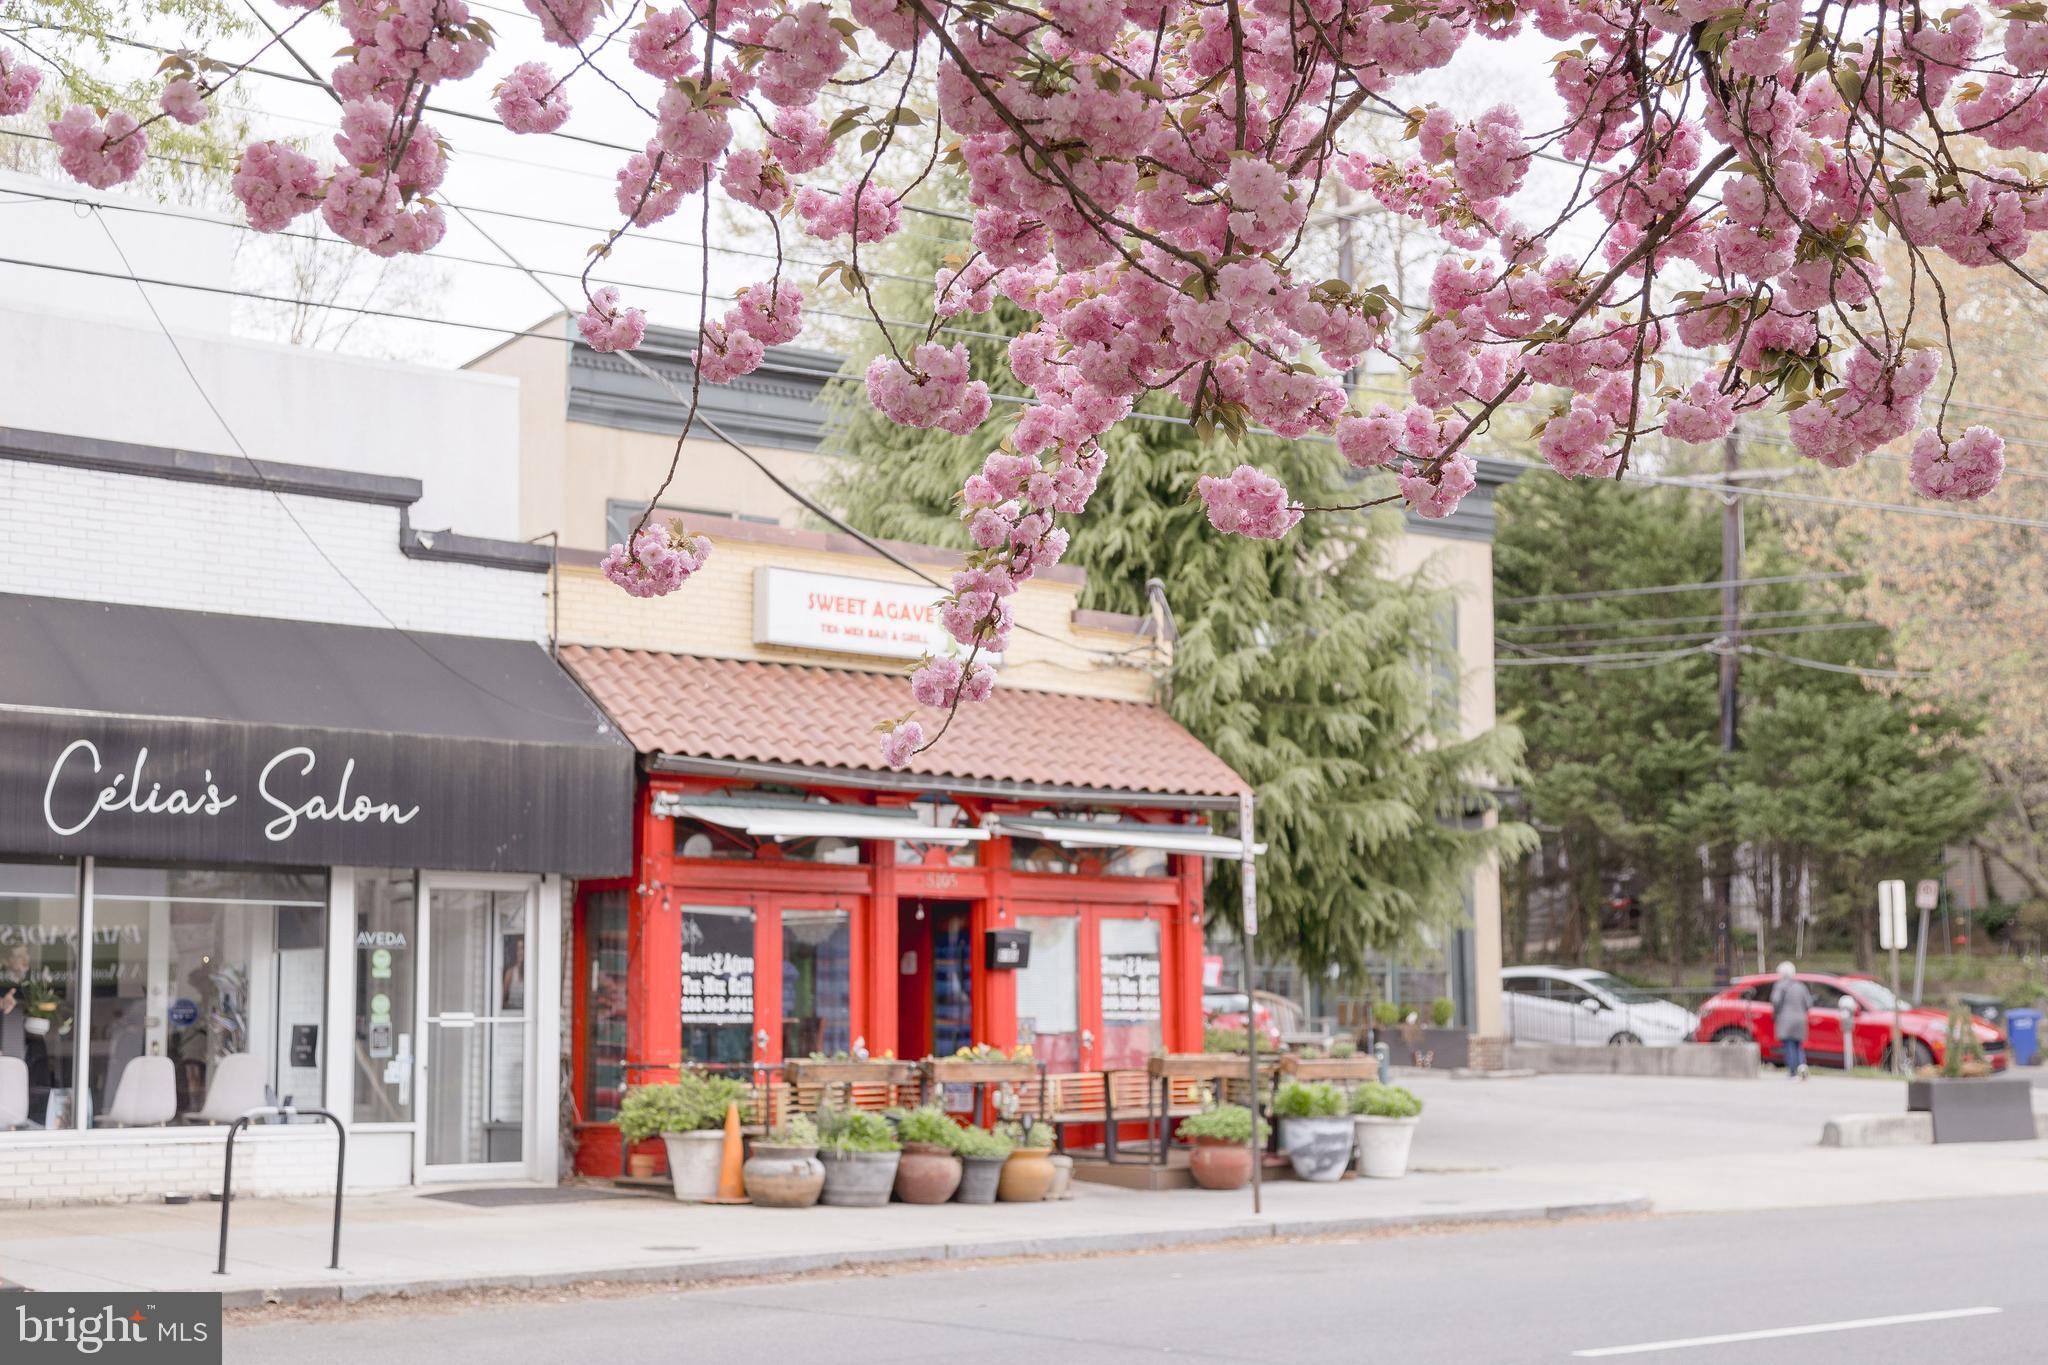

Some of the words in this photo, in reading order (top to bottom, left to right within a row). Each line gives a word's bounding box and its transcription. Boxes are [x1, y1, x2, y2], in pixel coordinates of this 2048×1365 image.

[808, 591, 867, 616] SWEET
[873, 600, 935, 624] AGAVE
[902, 632, 929, 644] GRILL
[44, 739, 237, 836] Célia's
[258, 746, 420, 841] Salon
[357, 931, 406, 946] AVEDA
